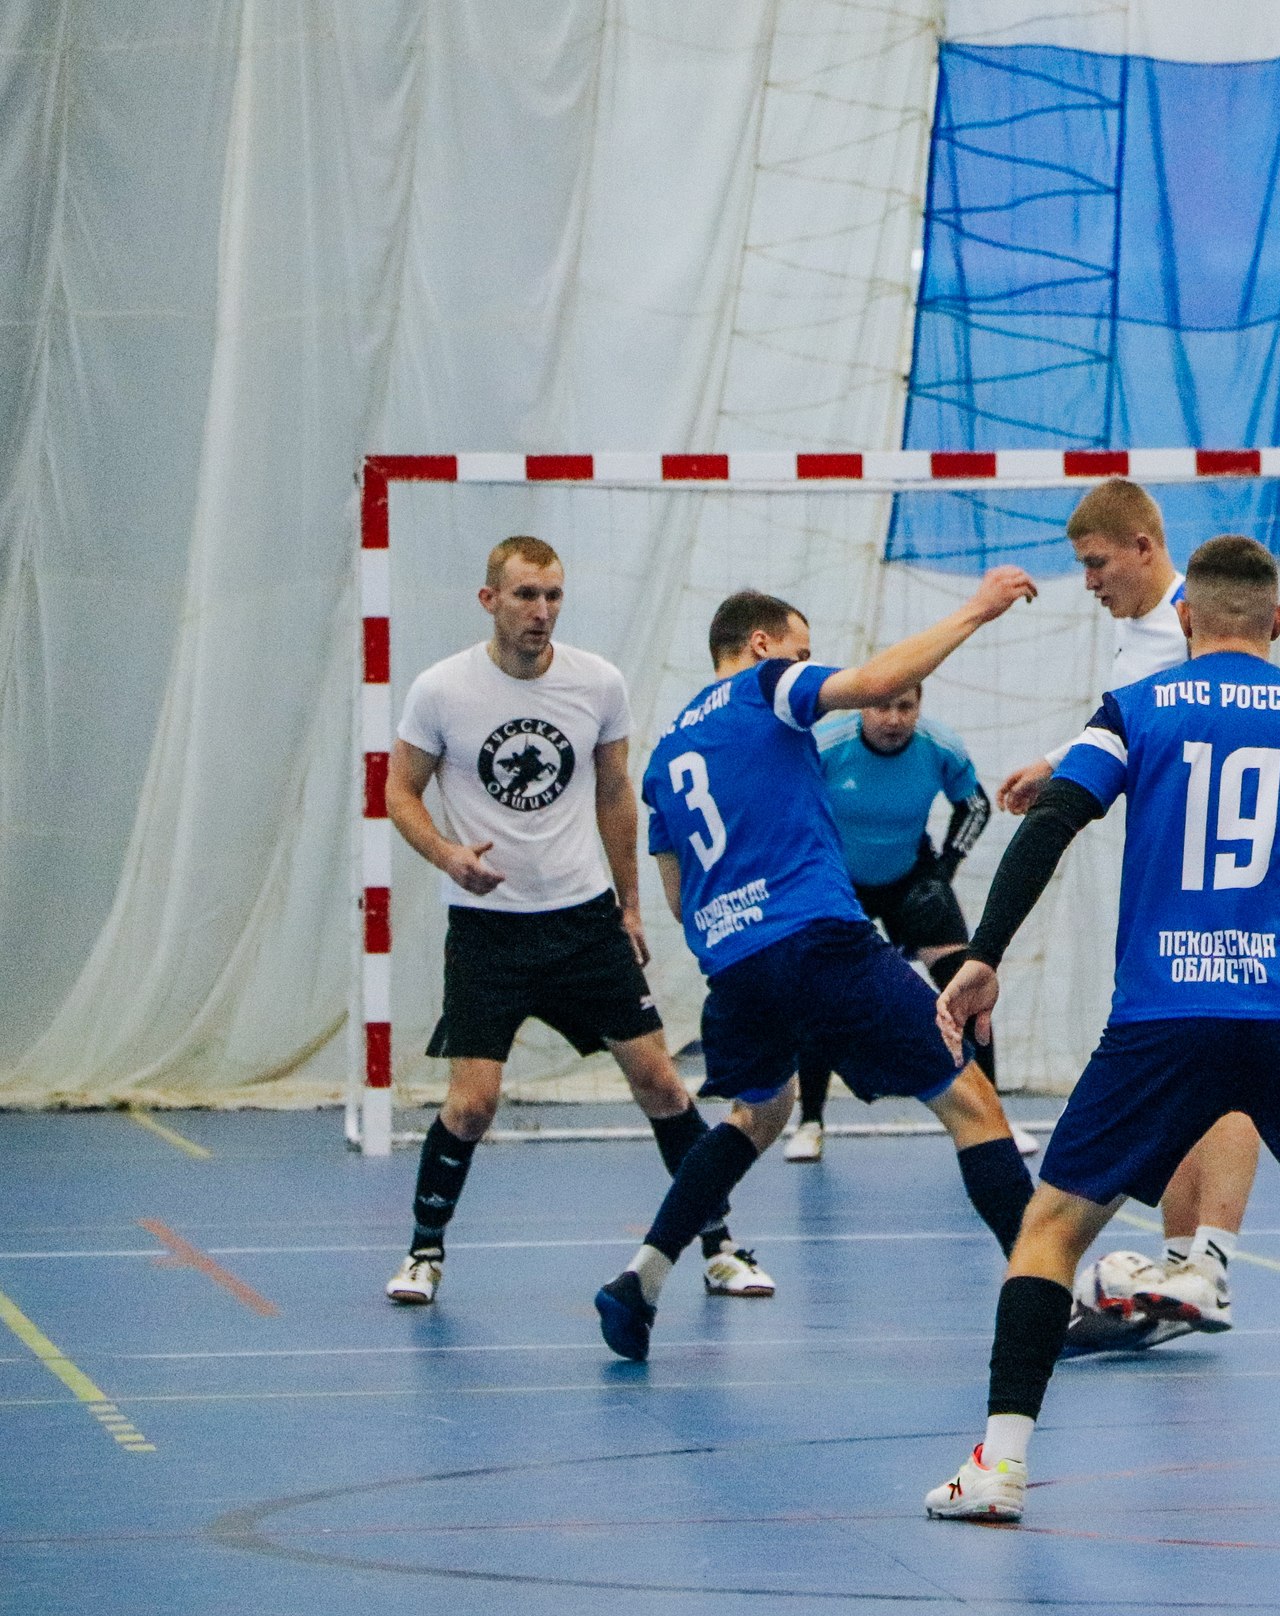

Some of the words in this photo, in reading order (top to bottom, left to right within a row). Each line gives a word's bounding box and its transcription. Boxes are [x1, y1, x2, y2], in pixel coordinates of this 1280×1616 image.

[1154, 680, 1211, 708] МЧС
[483, 719, 570, 754] РУССКАЯ
[668, 750, 727, 873] 3
[1158, 929, 1277, 958] ПСКОВСКАЯ
[1171, 956, 1268, 985] ОБЛАСТЬ
